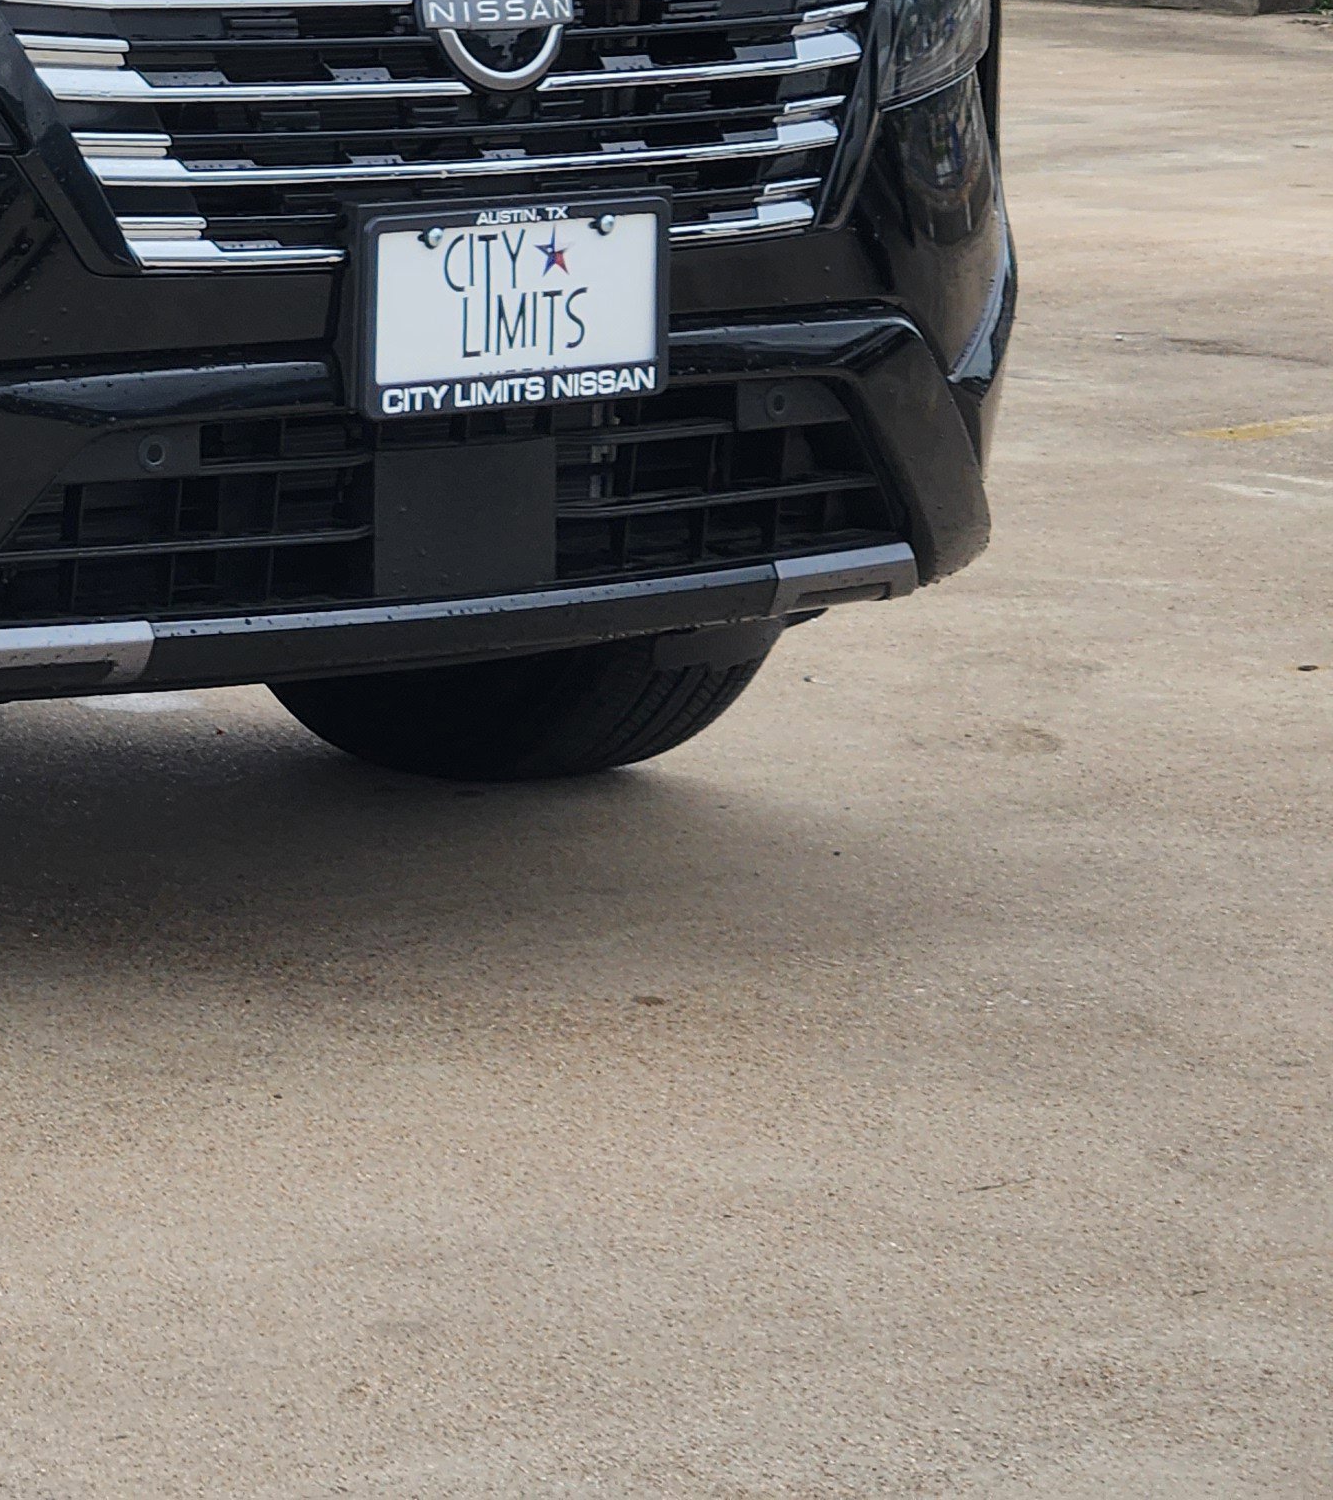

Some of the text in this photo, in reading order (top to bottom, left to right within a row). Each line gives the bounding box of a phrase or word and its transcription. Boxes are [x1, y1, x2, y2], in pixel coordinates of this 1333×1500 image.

[476, 205, 569, 226] AUSTIN, TX
[443, 228, 527, 292] CITY
[462, 286, 589, 359] LIMITS
[381, 385, 451, 415] CITY
[453, 377, 546, 408] LIMITS
[551, 366, 657, 399] NISSAN
